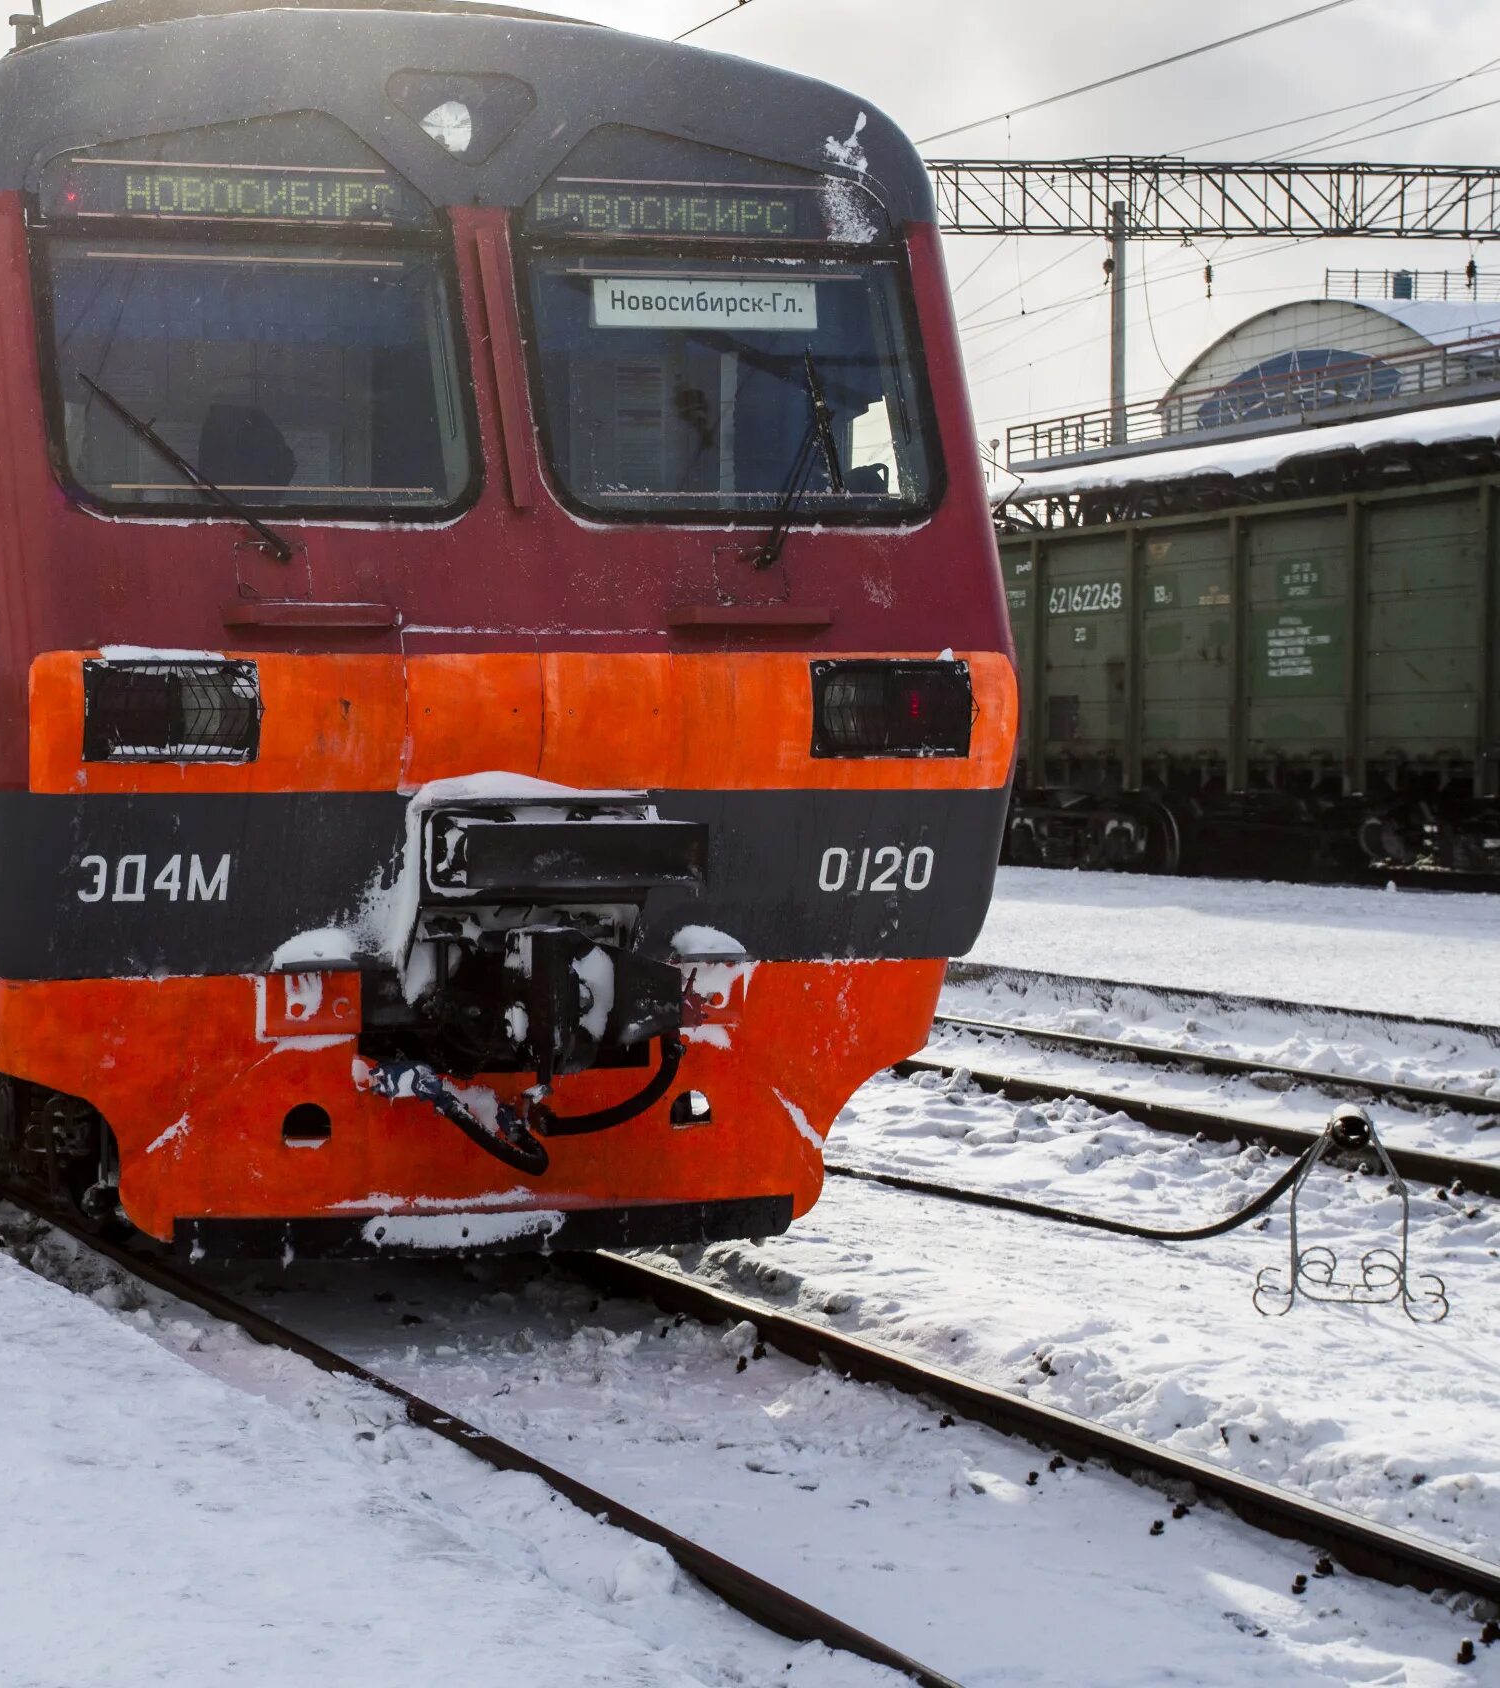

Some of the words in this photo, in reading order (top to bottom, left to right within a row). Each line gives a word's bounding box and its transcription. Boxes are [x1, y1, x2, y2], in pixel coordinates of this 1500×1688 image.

[610, 289, 804, 317] Новосибирск-Гл.
[1049, 582, 1122, 614] 62162268
[77, 854, 231, 902] ЭД4М
[818, 846, 935, 892] 0120
